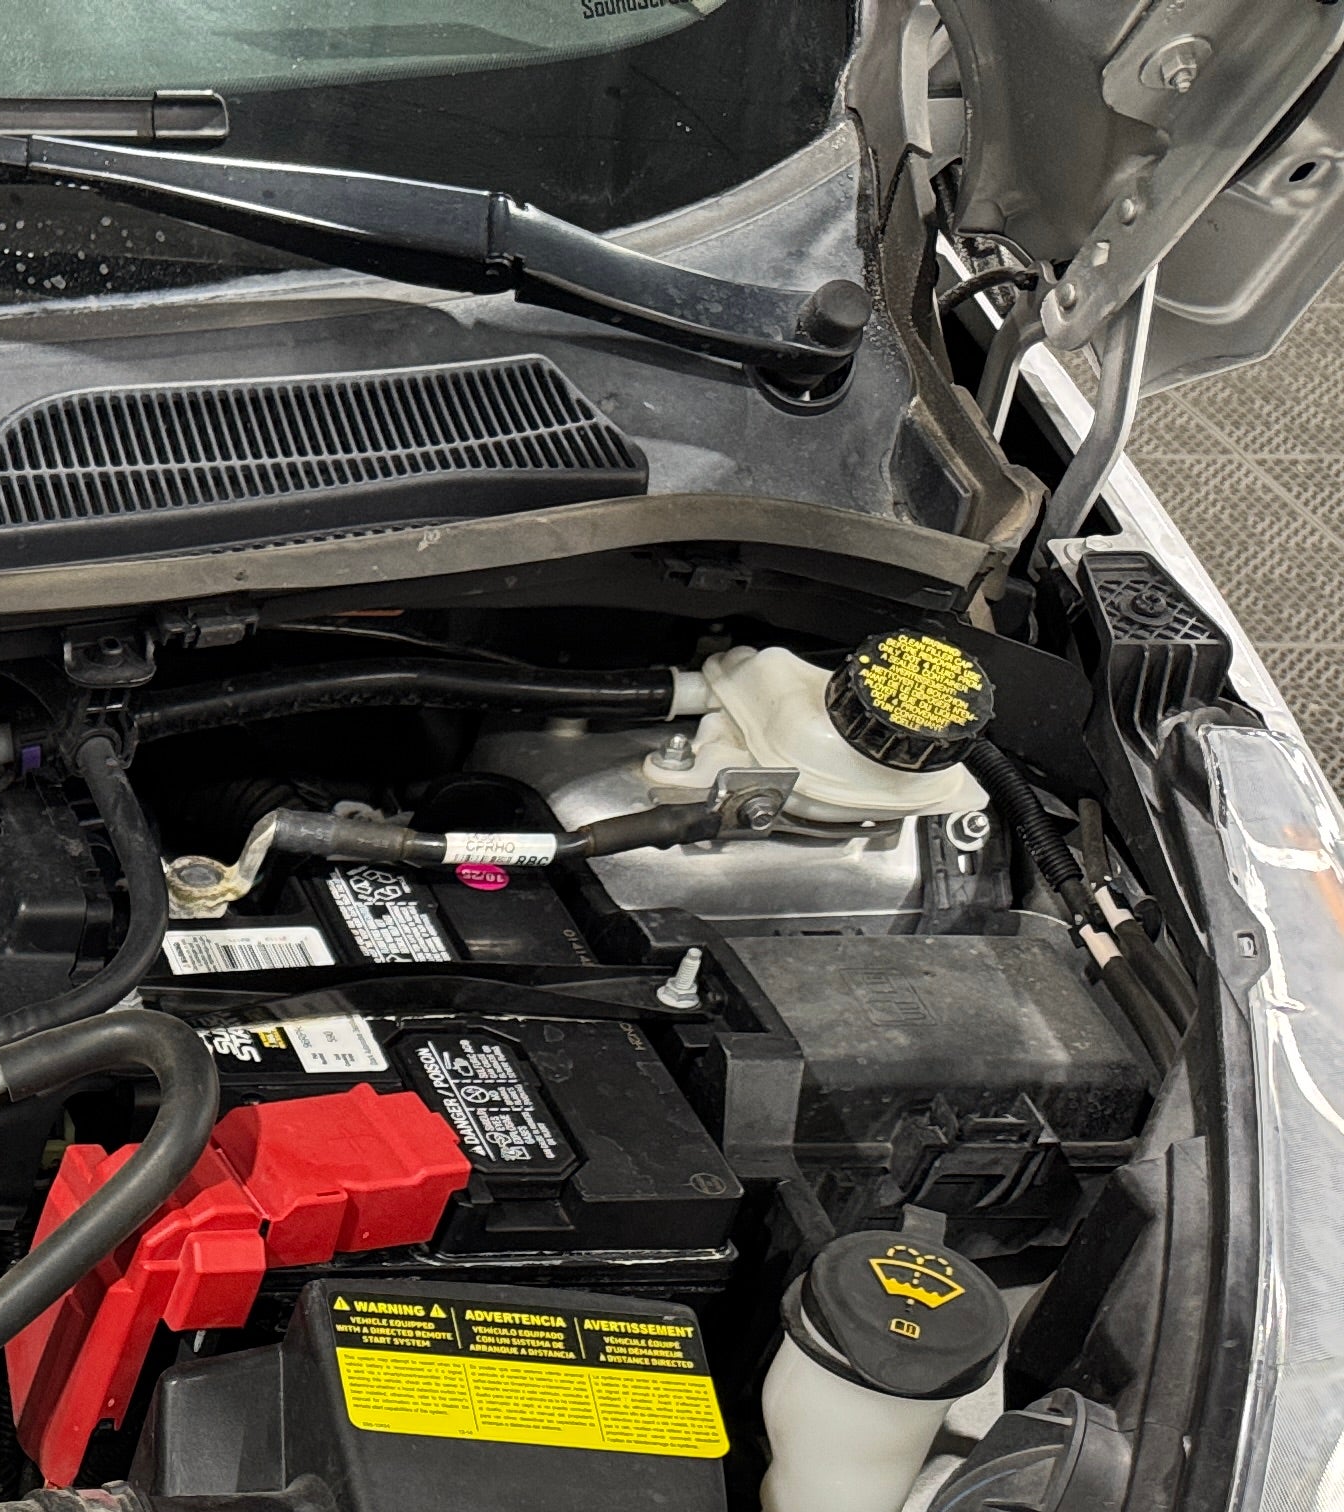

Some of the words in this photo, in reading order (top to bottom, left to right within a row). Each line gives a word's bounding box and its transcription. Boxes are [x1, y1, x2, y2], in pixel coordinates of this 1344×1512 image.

[415, 1047, 450, 1088] POISON
[443, 1098, 480, 1144] DANGER
[354, 1300, 426, 1316] WARNING
[350, 1316, 388, 1326] VEHICLE
[389, 1320, 436, 1330] EQUIPPED
[465, 1309, 567, 1328] ADVERTENCIA
[336, 1324, 361, 1334] WITH
[362, 1326, 369, 1334] A
[370, 1327, 413, 1337] DIRECTED
[415, 1330, 454, 1340] REMOTE
[518, 1330, 564, 1340] EQUIPADO
[584, 1319, 694, 1338] AVERTISSEMENT
[362, 1336, 391, 1345] START
[393, 1338, 431, 1348] SYSTEM
[476, 1335, 496, 1344] CON
[497, 1337, 510, 1345] UN
[512, 1338, 550, 1348] SISTEMA
[552, 1341, 564, 1349] DE
[606, 1346, 626, 1354] D'UN
[469, 1344, 518, 1355] ARRANQUE
[528, 1349, 576, 1360] DISTANCIA
[607, 1354, 650, 1365] DISTANCE
[652, 1358, 694, 1369] DIRECTED
